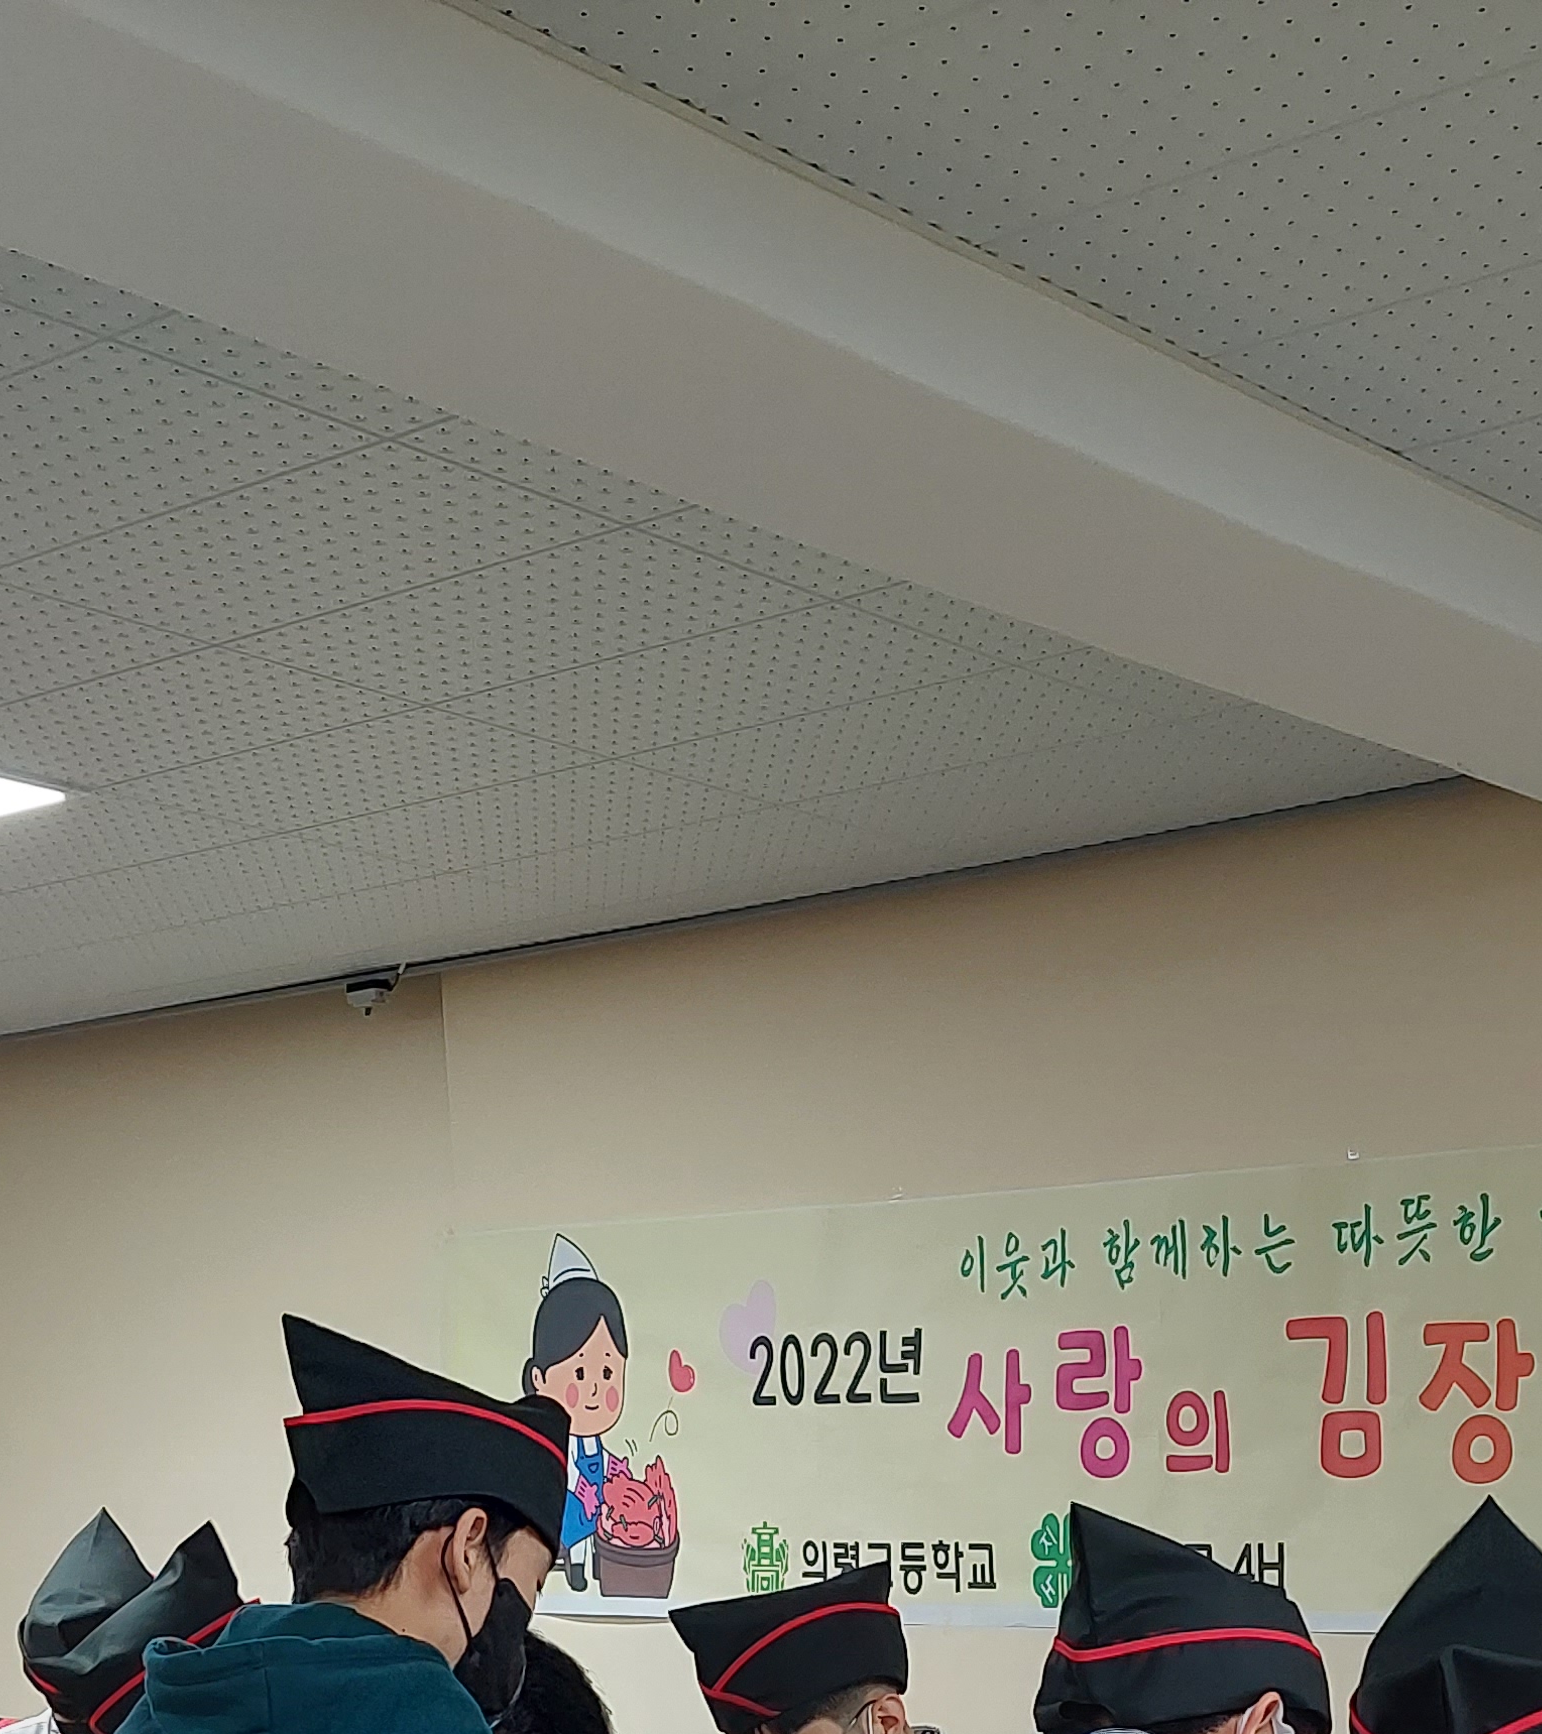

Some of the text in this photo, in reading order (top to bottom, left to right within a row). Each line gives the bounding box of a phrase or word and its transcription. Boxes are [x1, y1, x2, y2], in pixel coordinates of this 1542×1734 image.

[960, 1227, 1076, 1300] 이웃과
[1102, 1213, 1296, 1291] 함께하는
[1331, 1193, 1501, 1268] 따뜻한
[749, 1327, 922, 1406] 2022년
[946, 1325, 1231, 1479] 사랑의
[1285, 1310, 1536, 1485] 김장
